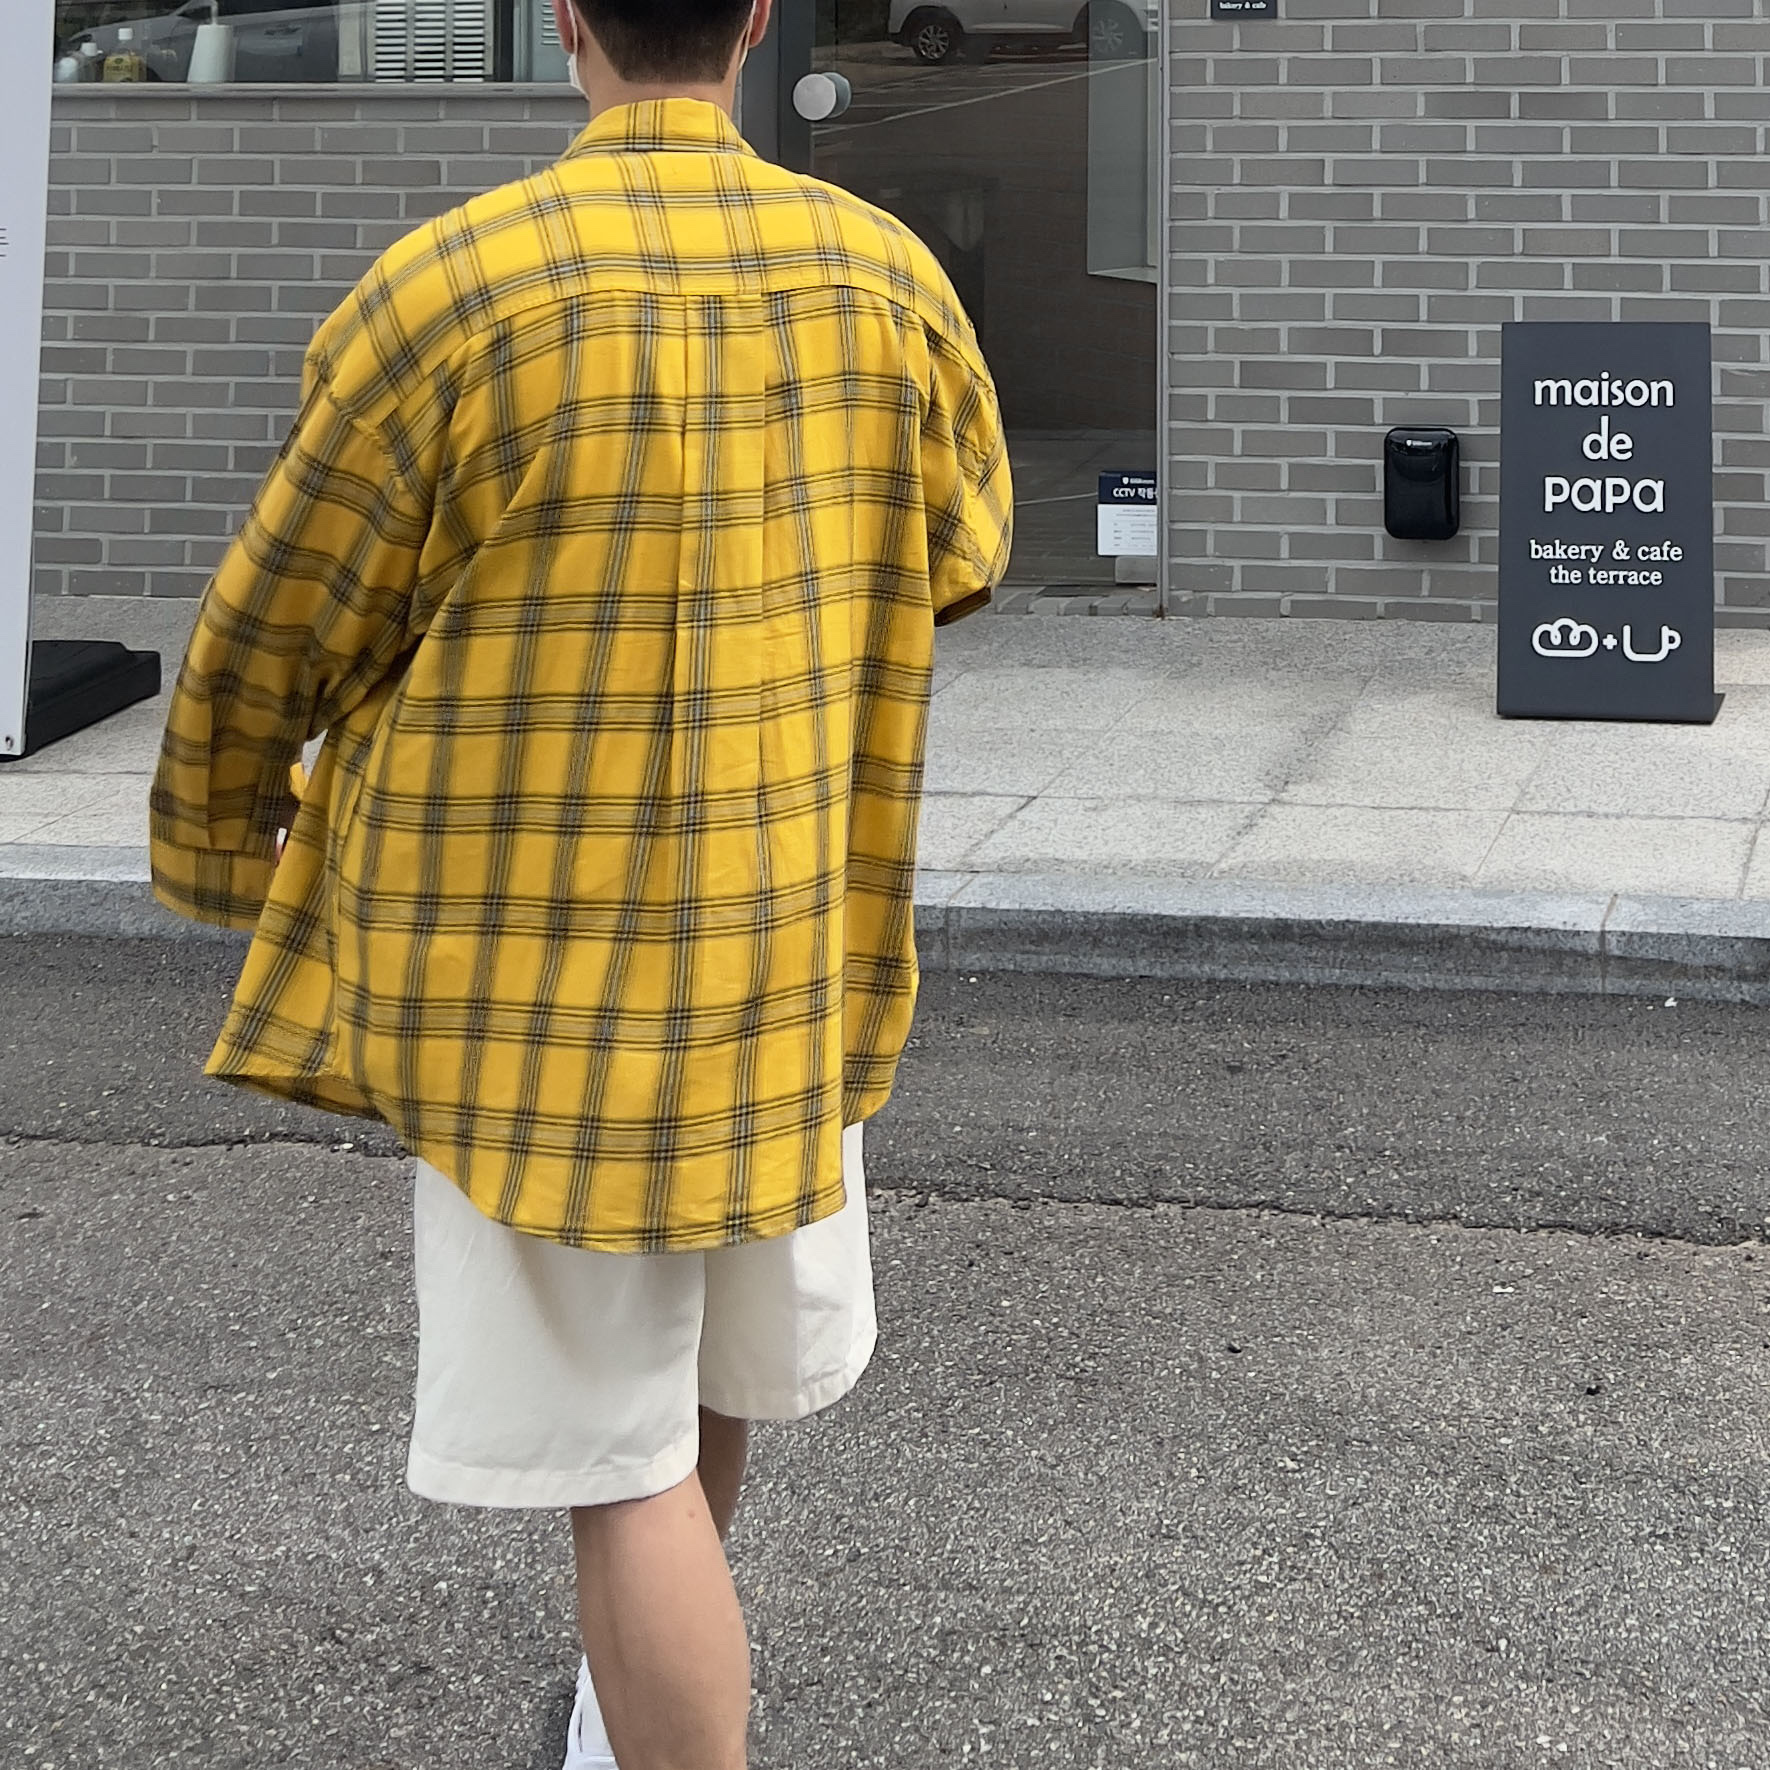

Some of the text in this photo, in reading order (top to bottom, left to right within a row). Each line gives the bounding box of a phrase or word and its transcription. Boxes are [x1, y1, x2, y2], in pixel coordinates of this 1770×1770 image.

[1533, 371, 1674, 407] maison
[1582, 415, 1633, 460] de
[1113, 487, 1158, 499] CCTV 작동
[1529, 539, 1682, 563] bakery & cafe
[1550, 565, 1662, 585] the terrace
